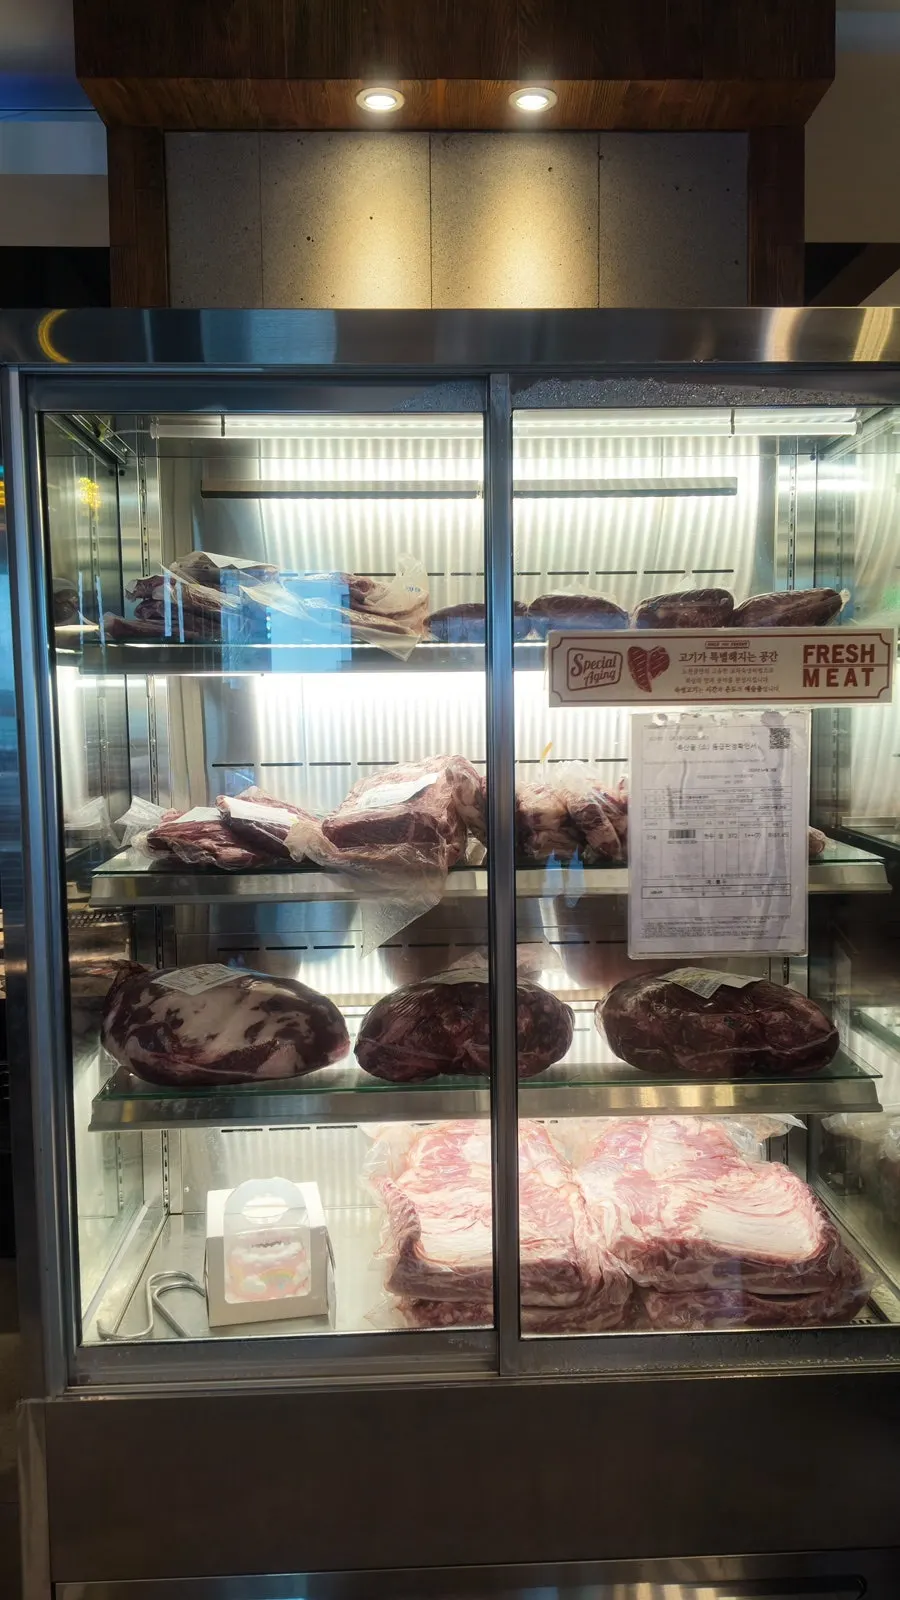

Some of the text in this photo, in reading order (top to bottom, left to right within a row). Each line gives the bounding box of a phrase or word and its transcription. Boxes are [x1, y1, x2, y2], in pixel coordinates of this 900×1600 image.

[679, 651, 778, 663] 고기가 특별해지는 공간
[803, 644, 875, 664] FRESH
[570, 653, 617, 676] Special
[583, 669, 617, 686] Aging
[802, 667, 875, 688] MEAT
